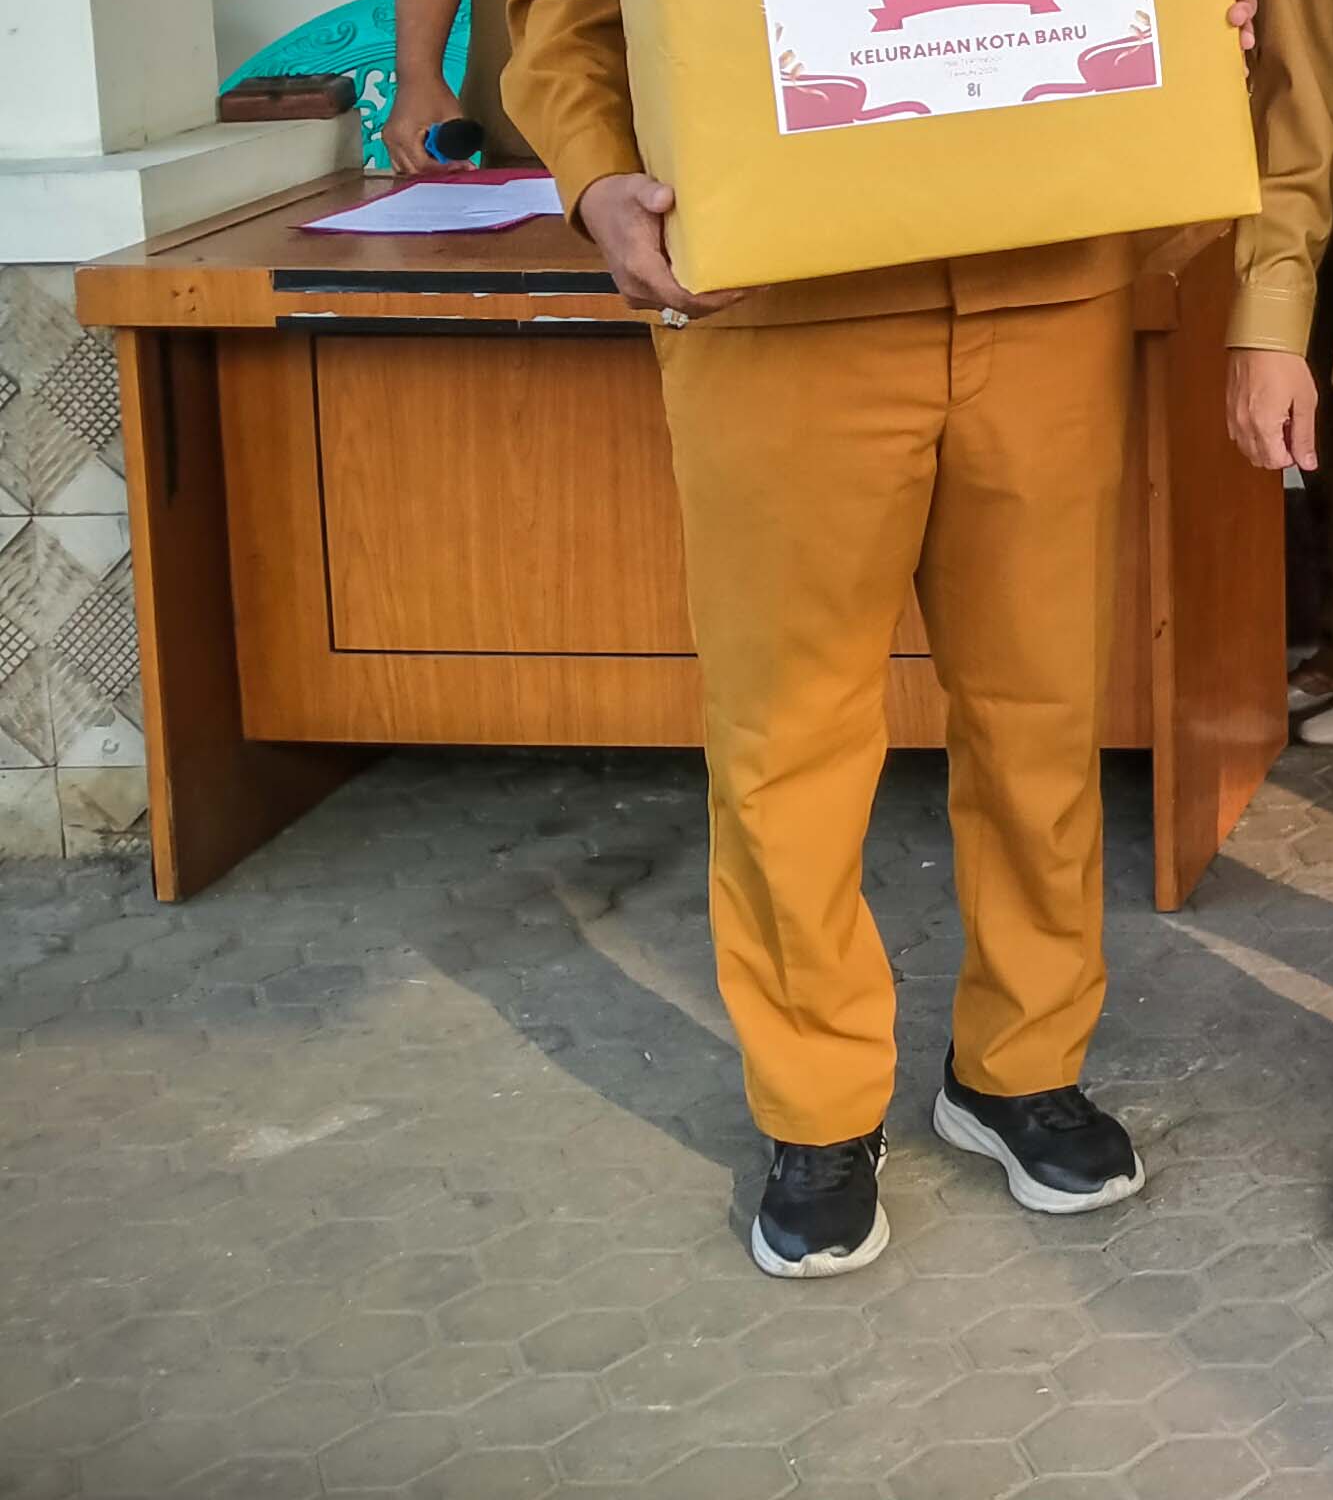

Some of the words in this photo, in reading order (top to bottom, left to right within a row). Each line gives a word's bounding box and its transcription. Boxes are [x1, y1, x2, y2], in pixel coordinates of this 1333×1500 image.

[849, 38, 971, 67] KELURAHAN
[975, 31, 1031, 53] KOTA
[1034, 24, 1088, 46] BARU
